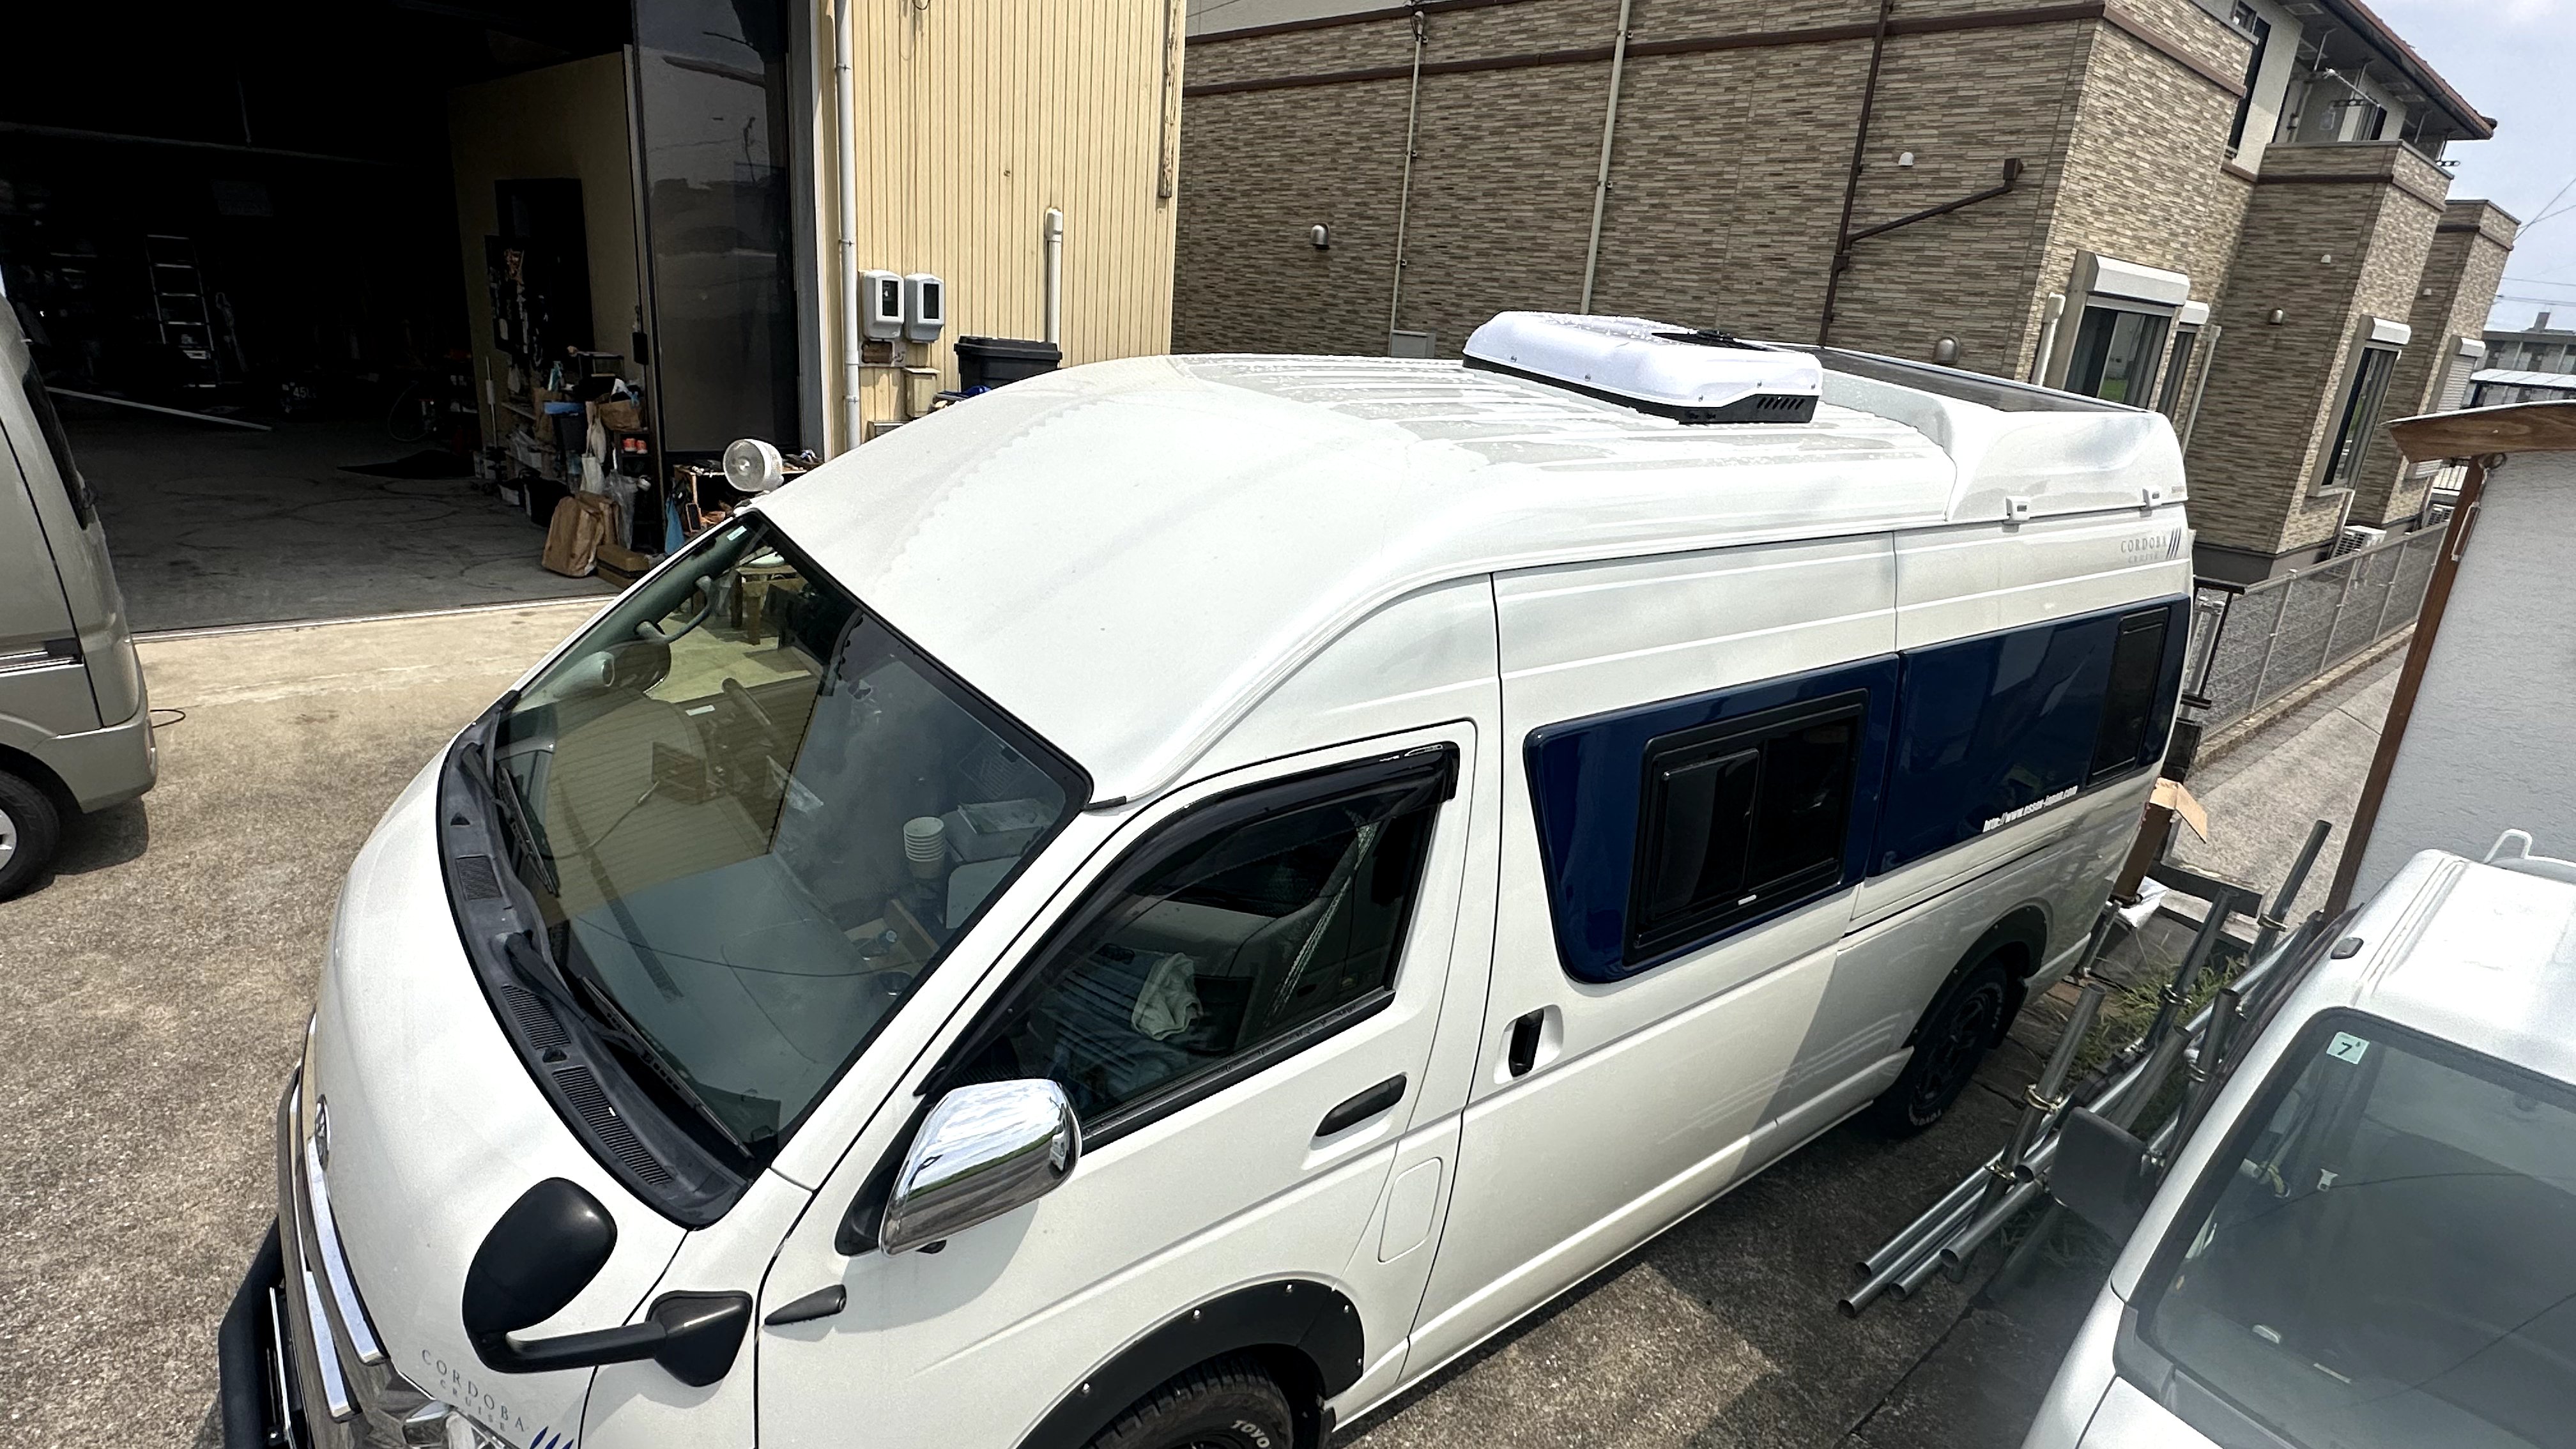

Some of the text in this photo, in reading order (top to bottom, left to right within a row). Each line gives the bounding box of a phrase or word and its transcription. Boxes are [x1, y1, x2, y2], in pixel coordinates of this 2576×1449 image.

[2121, 536, 2166, 553] CORDOBA
[2338, 1042, 2352, 1055] 7
[422, 1349, 525, 1432] CORDOBA
[440, 1379, 505, 1431] CRUISE
[1230, 1420, 1270, 1448] TOYO
